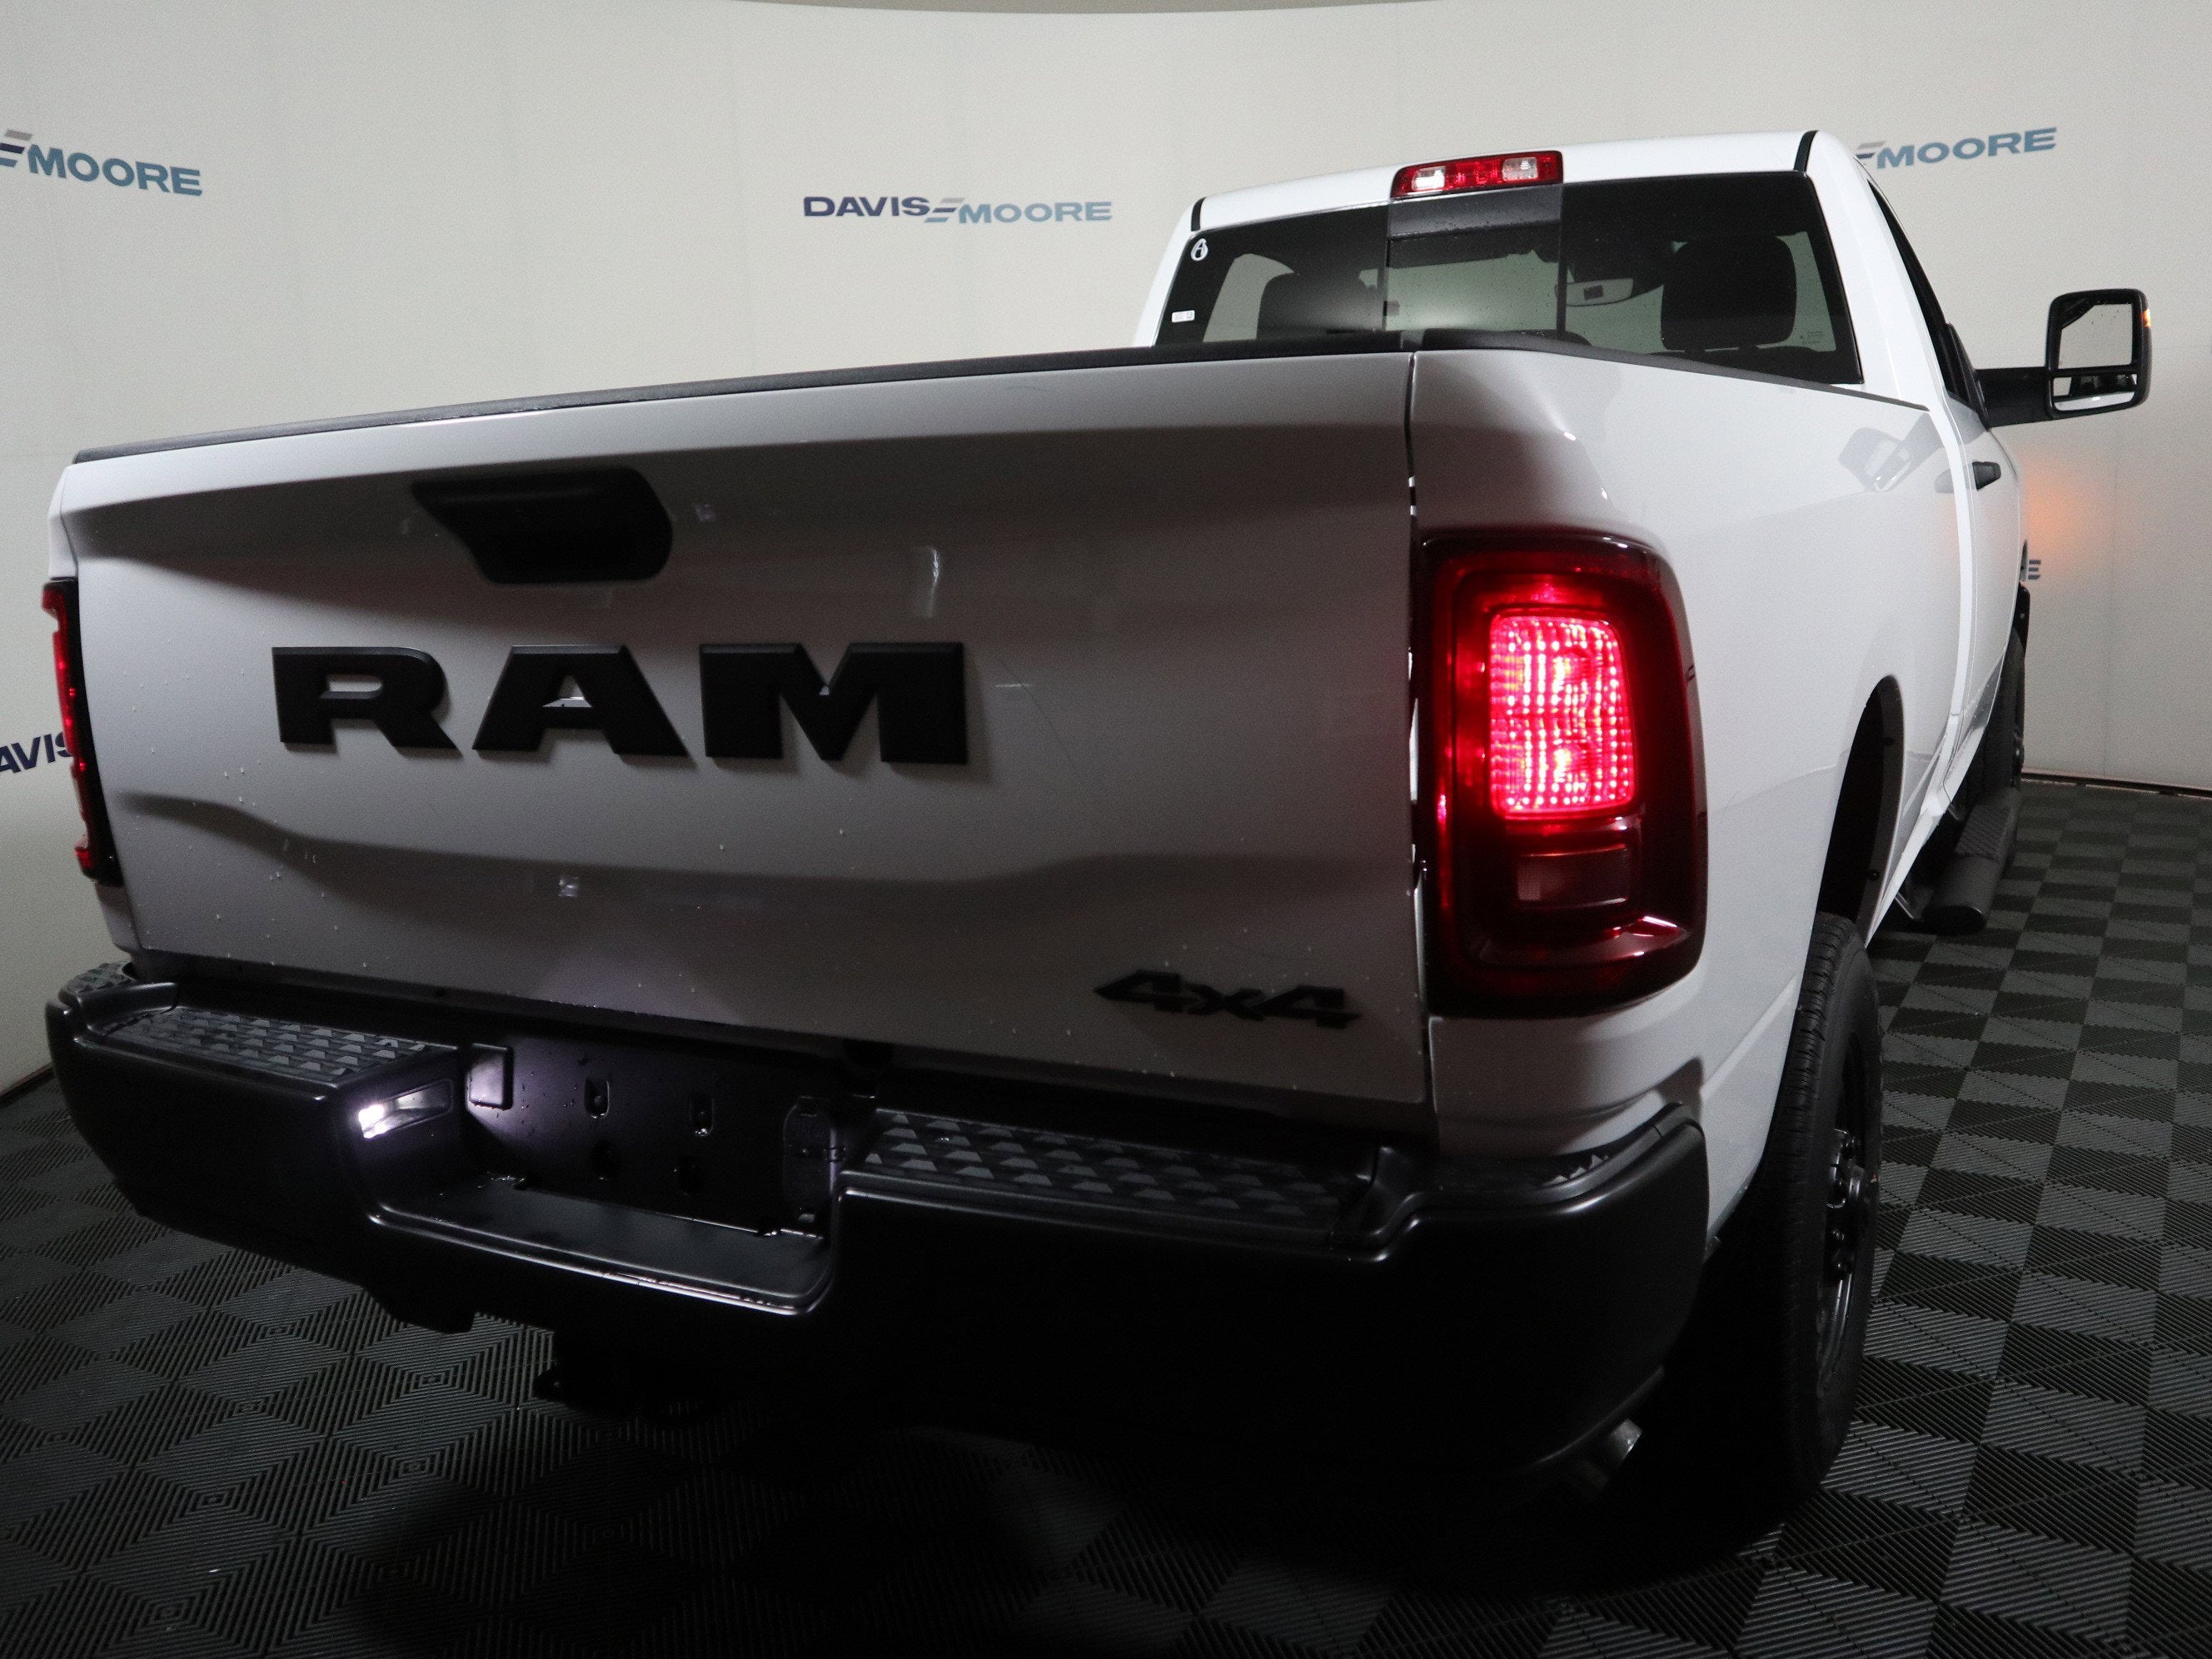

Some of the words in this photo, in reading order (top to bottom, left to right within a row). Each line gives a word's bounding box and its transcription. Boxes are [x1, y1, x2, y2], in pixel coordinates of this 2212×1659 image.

[27, 143, 203, 197] MOORE
[1876, 127, 2057, 169] MOORE
[803, 196, 930, 217] DAVIS
[959, 202, 1113, 223] MOORE
[272, 642, 968, 764] RAM
